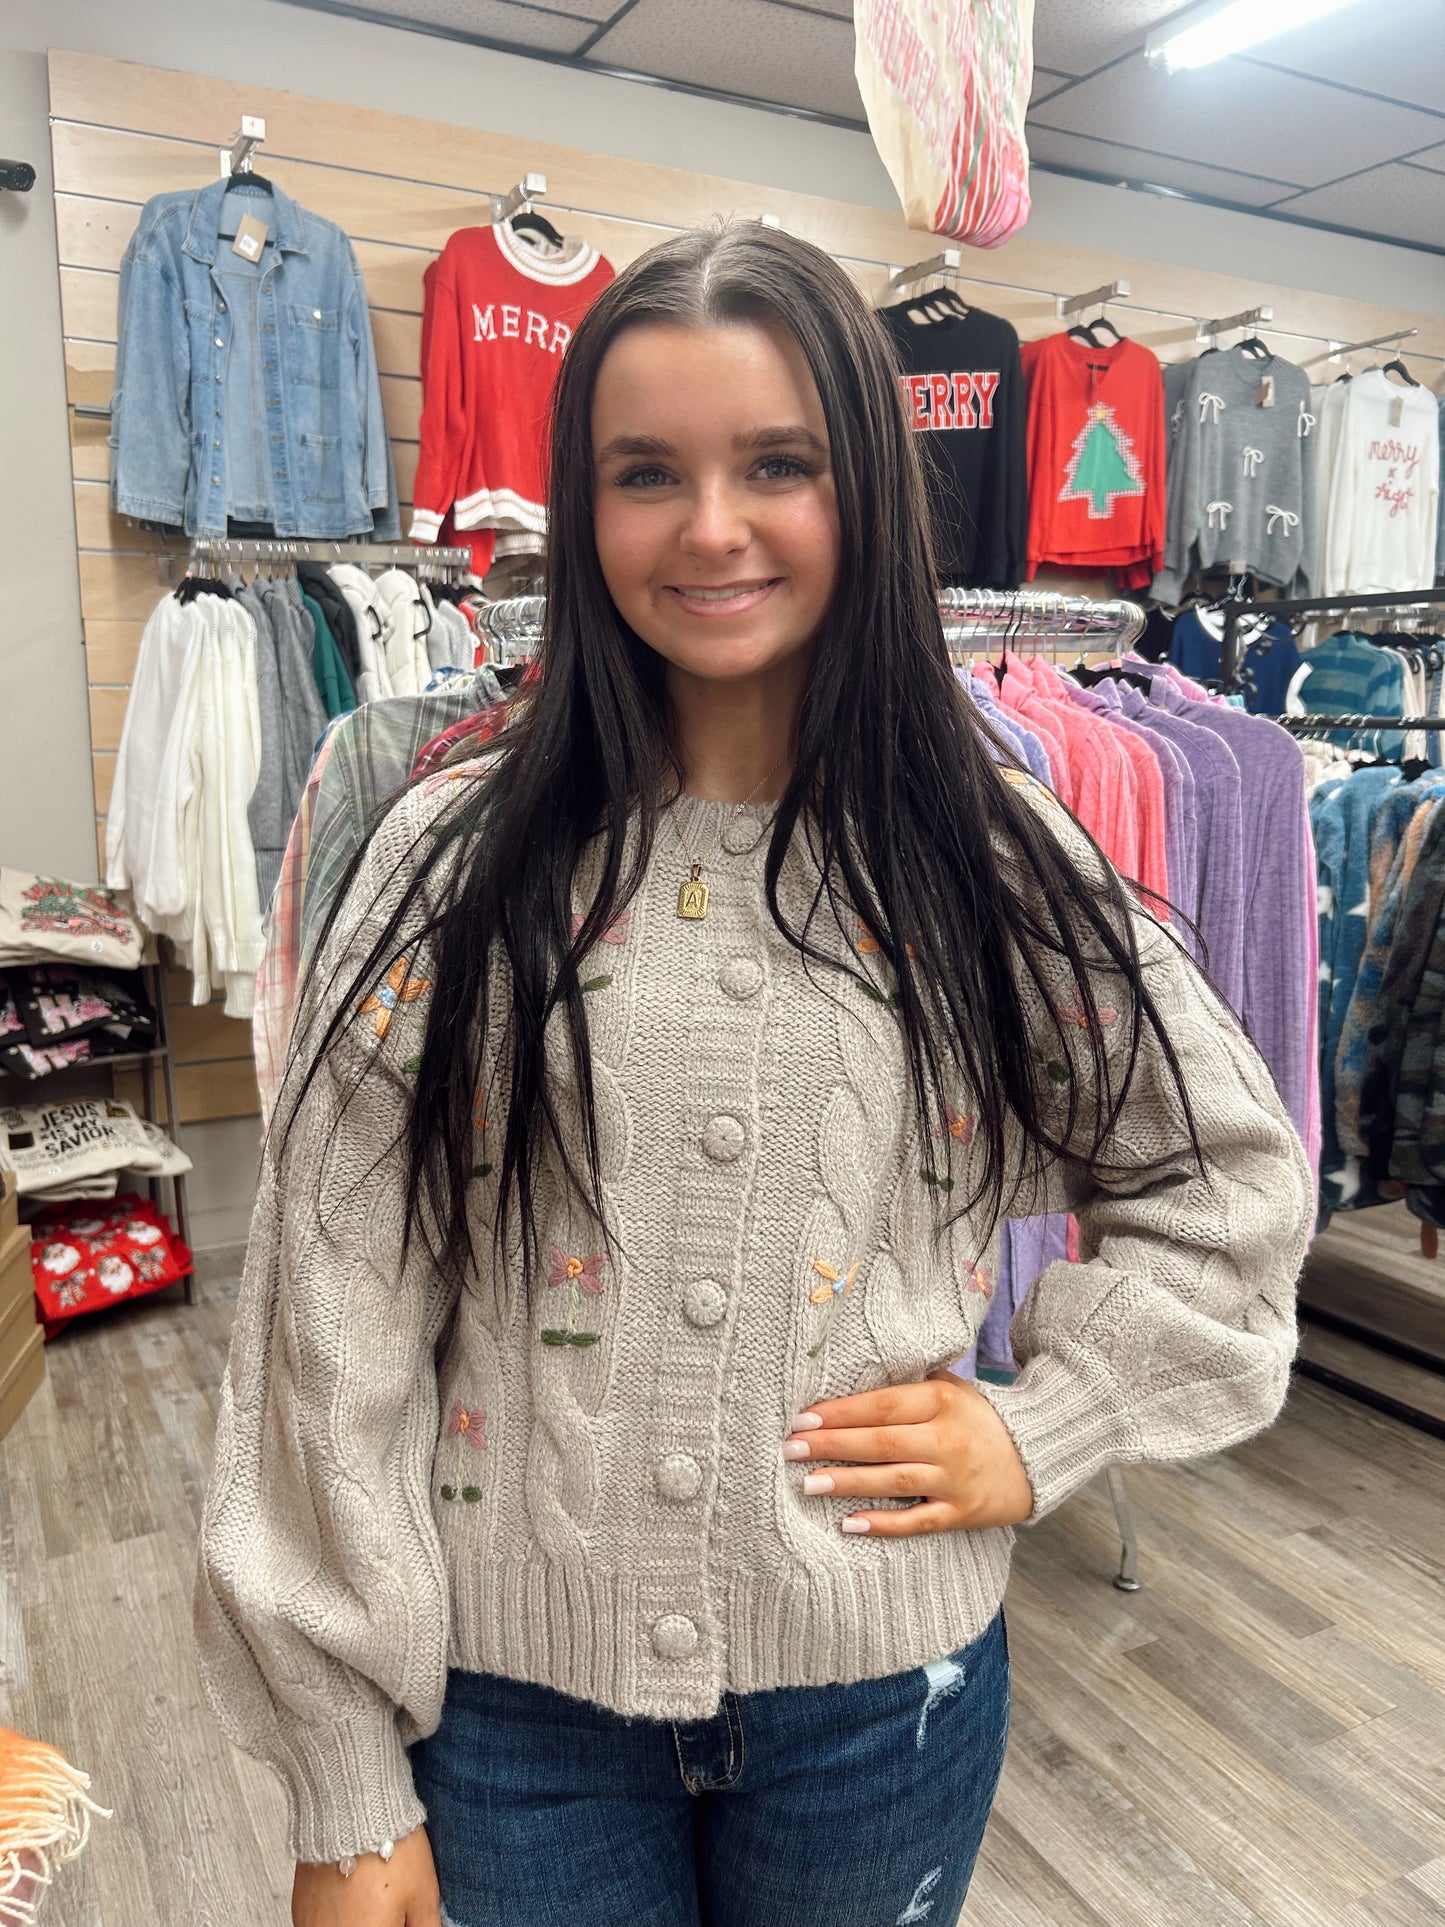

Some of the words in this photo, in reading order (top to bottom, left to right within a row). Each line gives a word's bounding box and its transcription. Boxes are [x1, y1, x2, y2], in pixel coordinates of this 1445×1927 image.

[472, 304, 573, 360] MERR
[898, 371, 1001, 432] ERRY
[1368, 439, 1419, 479] merry
[685, 891, 699, 908] A
[40, 1102, 99, 1131] JESUS
[51, 1129, 68, 1140] IS
[73, 1118, 99, 1131] MY
[45, 1126, 118, 1159] SAVIOR
